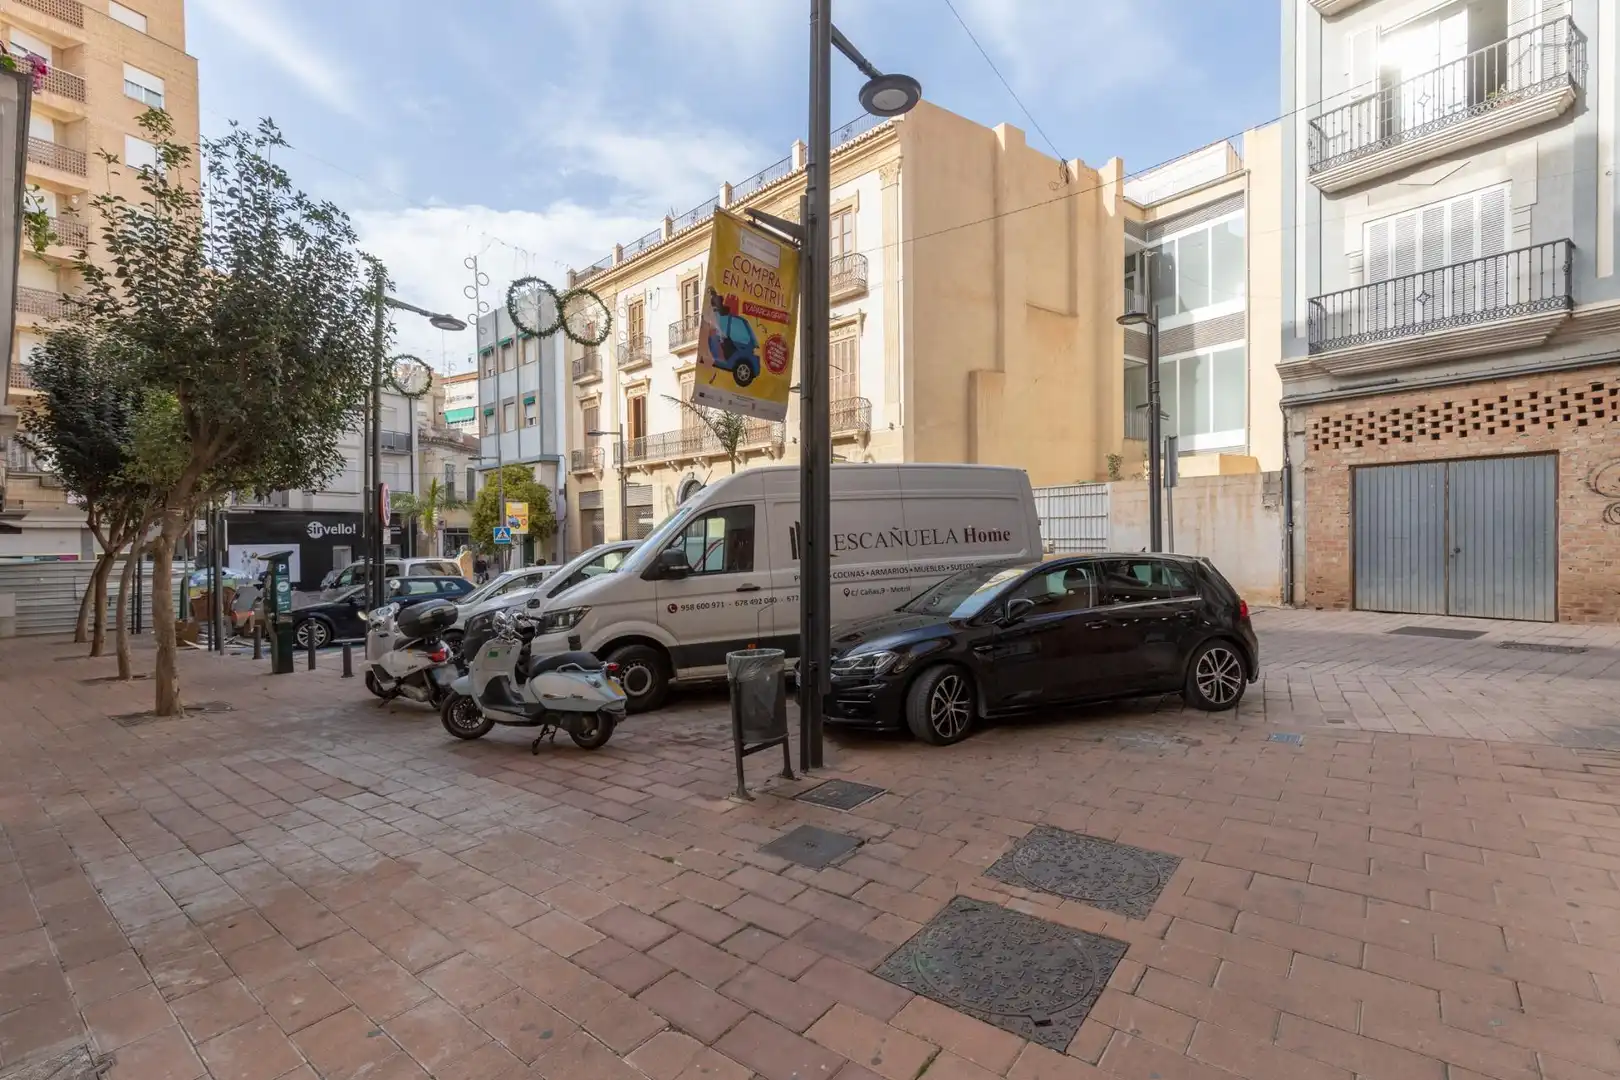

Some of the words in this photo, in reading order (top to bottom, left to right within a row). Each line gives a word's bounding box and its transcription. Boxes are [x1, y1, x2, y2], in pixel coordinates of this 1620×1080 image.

[732, 255, 782, 288] COMPRA
[722, 269, 740, 288] EN
[743, 279, 786, 308] MOTRIL
[833, 527, 958, 551] ESCAÑUELA
[964, 527, 1011, 544] Home
[278, 563, 286, 573] P
[833, 569, 865, 579] COCINAS
[870, 567, 909, 576] ARMARIOS
[914, 563, 946, 573] MUEBLES
[890, 585, 911, 593] Motril
[696, 602, 710, 610] 600
[711, 601, 725, 609] 971
[734, 599, 748, 607] 678
[749, 598, 763, 606] 492
[764, 596, 778, 604] 040
